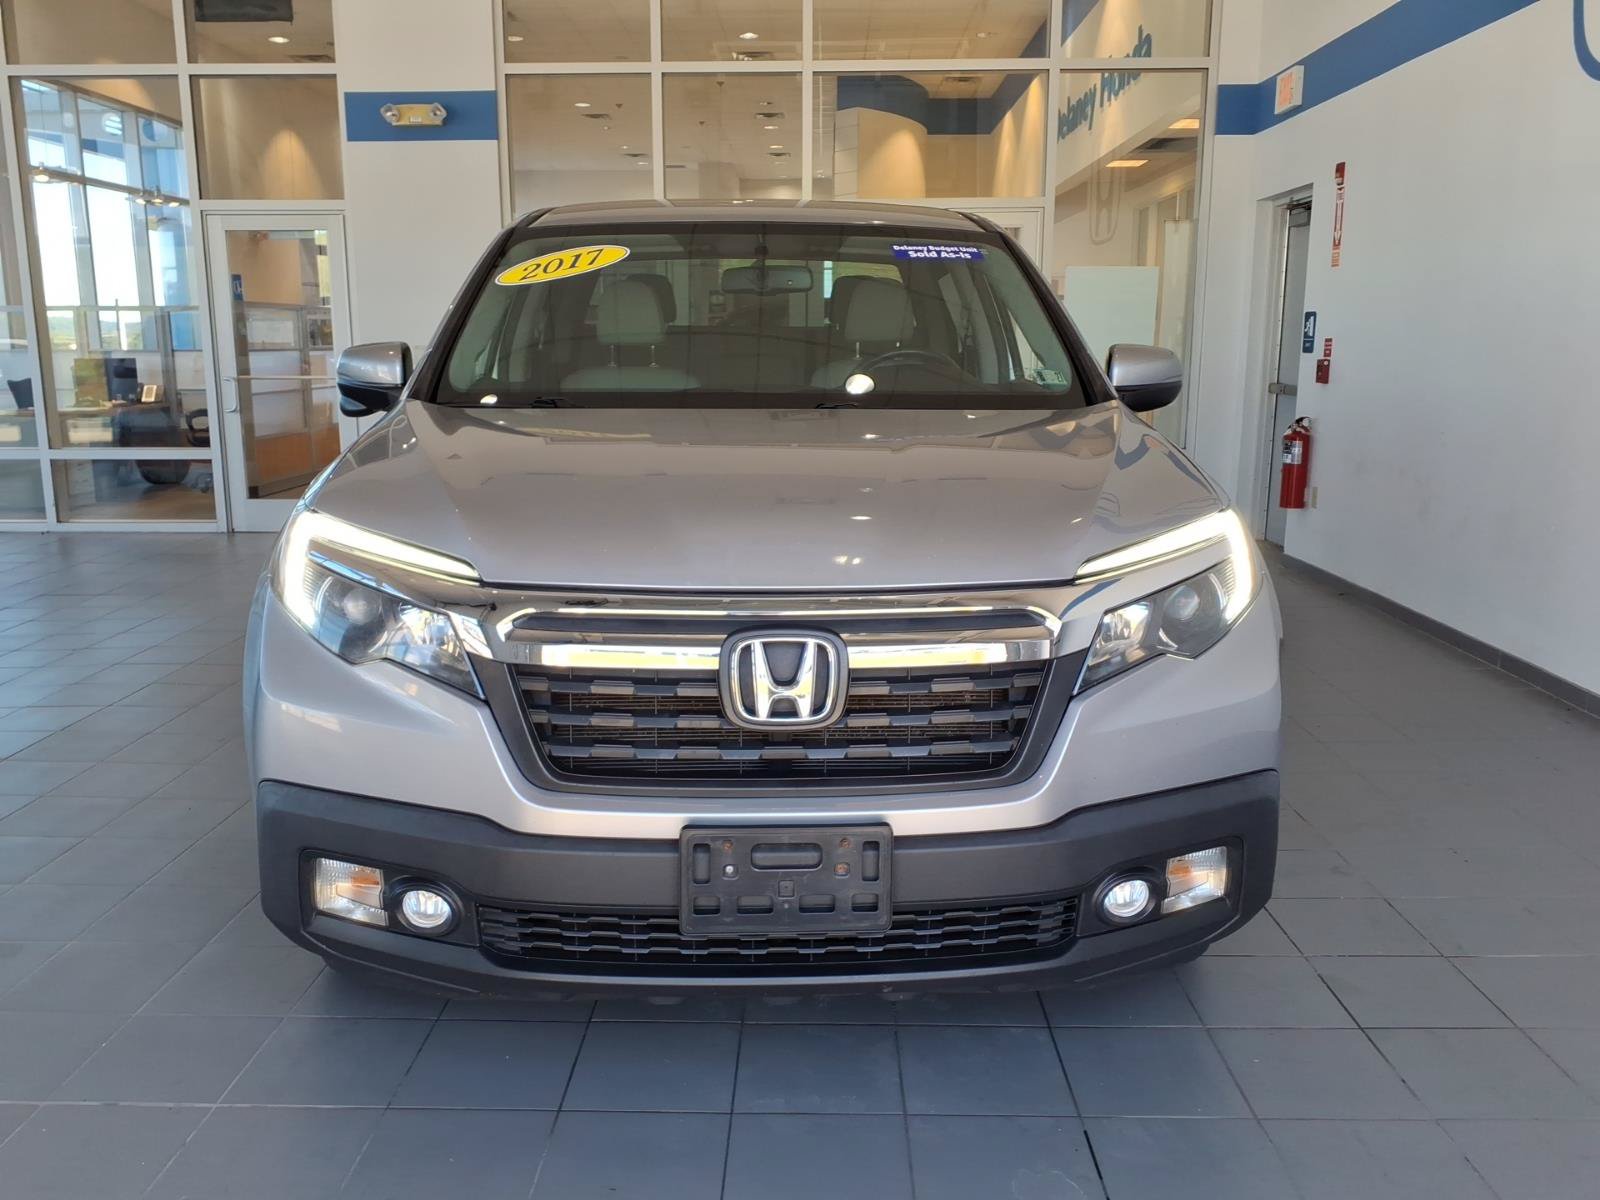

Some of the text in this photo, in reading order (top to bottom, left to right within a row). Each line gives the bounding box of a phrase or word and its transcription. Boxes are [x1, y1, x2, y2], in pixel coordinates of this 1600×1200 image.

[1057, 83, 1097, 144] elaney
[518, 248, 604, 281] 2017
[908, 250, 972, 259] Sold As-Is
